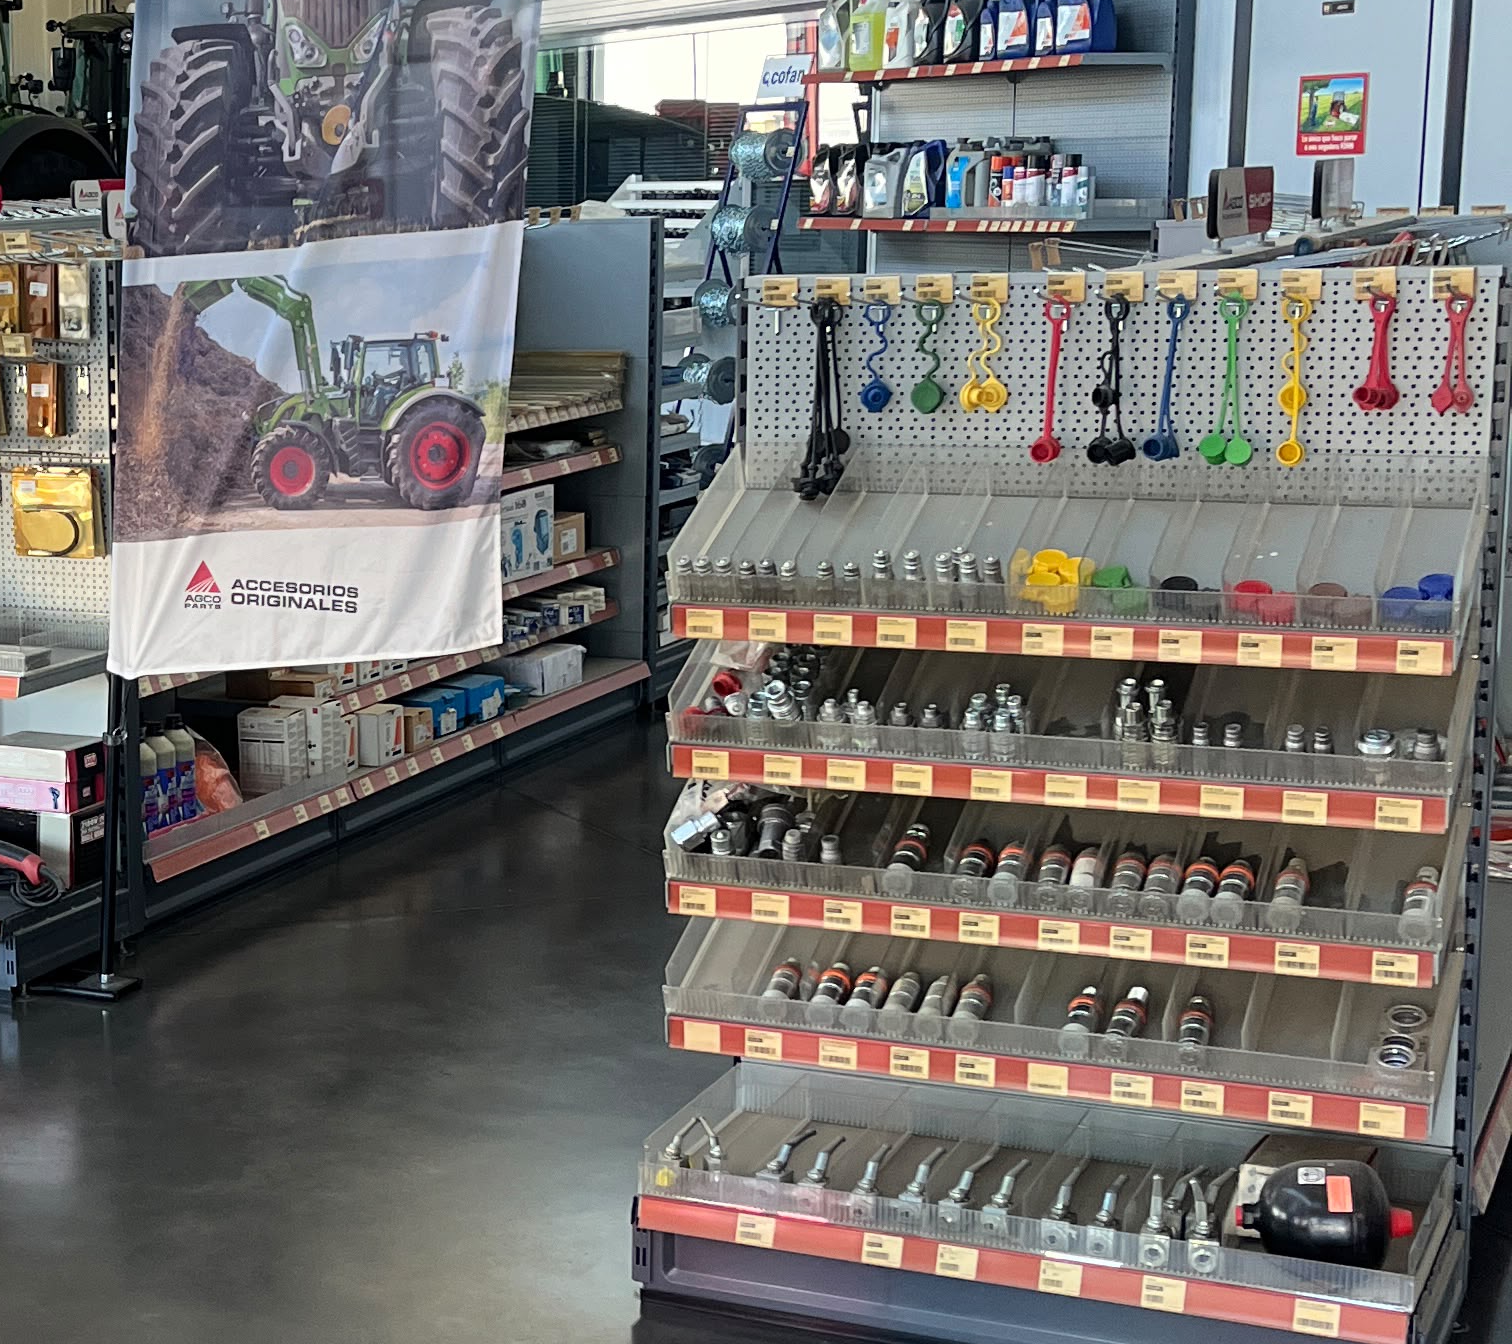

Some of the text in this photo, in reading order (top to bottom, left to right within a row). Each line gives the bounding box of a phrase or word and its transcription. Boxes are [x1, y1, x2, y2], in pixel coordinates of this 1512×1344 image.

[771, 65, 806, 86] cofan
[1249, 192, 1272, 209] SHOP
[184, 594, 222, 604] AGCO
[231, 579, 359, 599] ACCESORIOS
[230, 592, 358, 614] ORIGINALES
